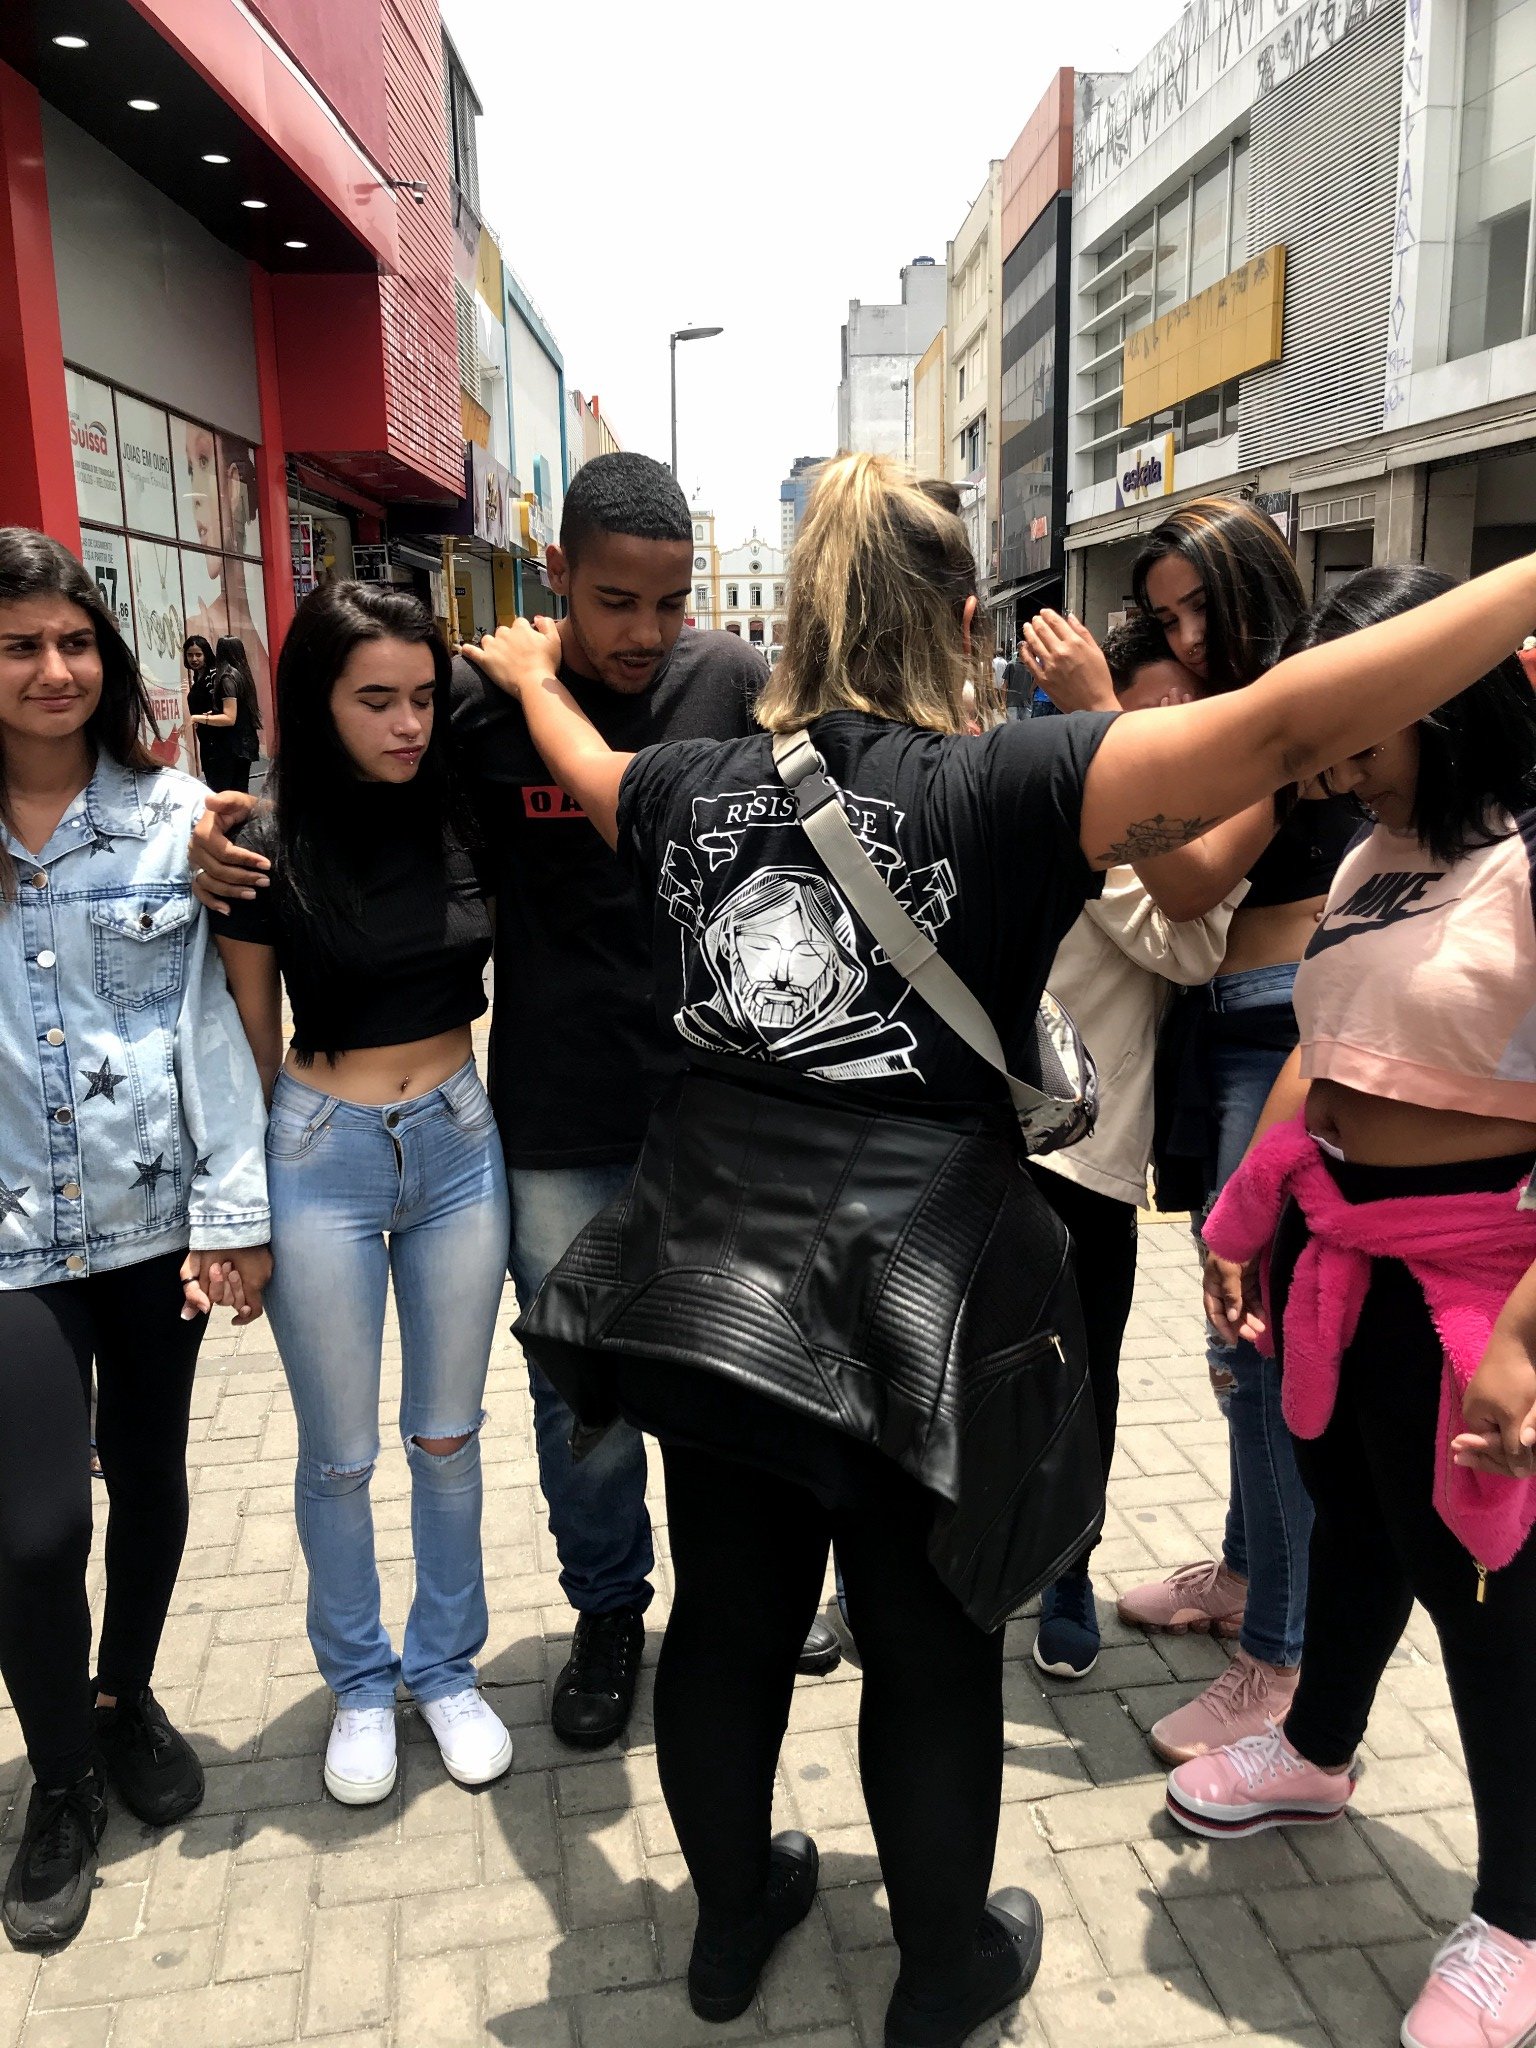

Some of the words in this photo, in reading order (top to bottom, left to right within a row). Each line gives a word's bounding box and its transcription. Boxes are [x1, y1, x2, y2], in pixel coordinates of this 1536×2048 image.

[69, 420, 108, 456] Suissa
[122, 442, 141, 464] JOIAS
[141, 449, 152, 468] EM
[153, 453, 170, 474] OURO
[1122, 451, 1162, 498] eskala
[149, 699, 180, 720] IREITA
[1333, 872, 1446, 919] NIKE
